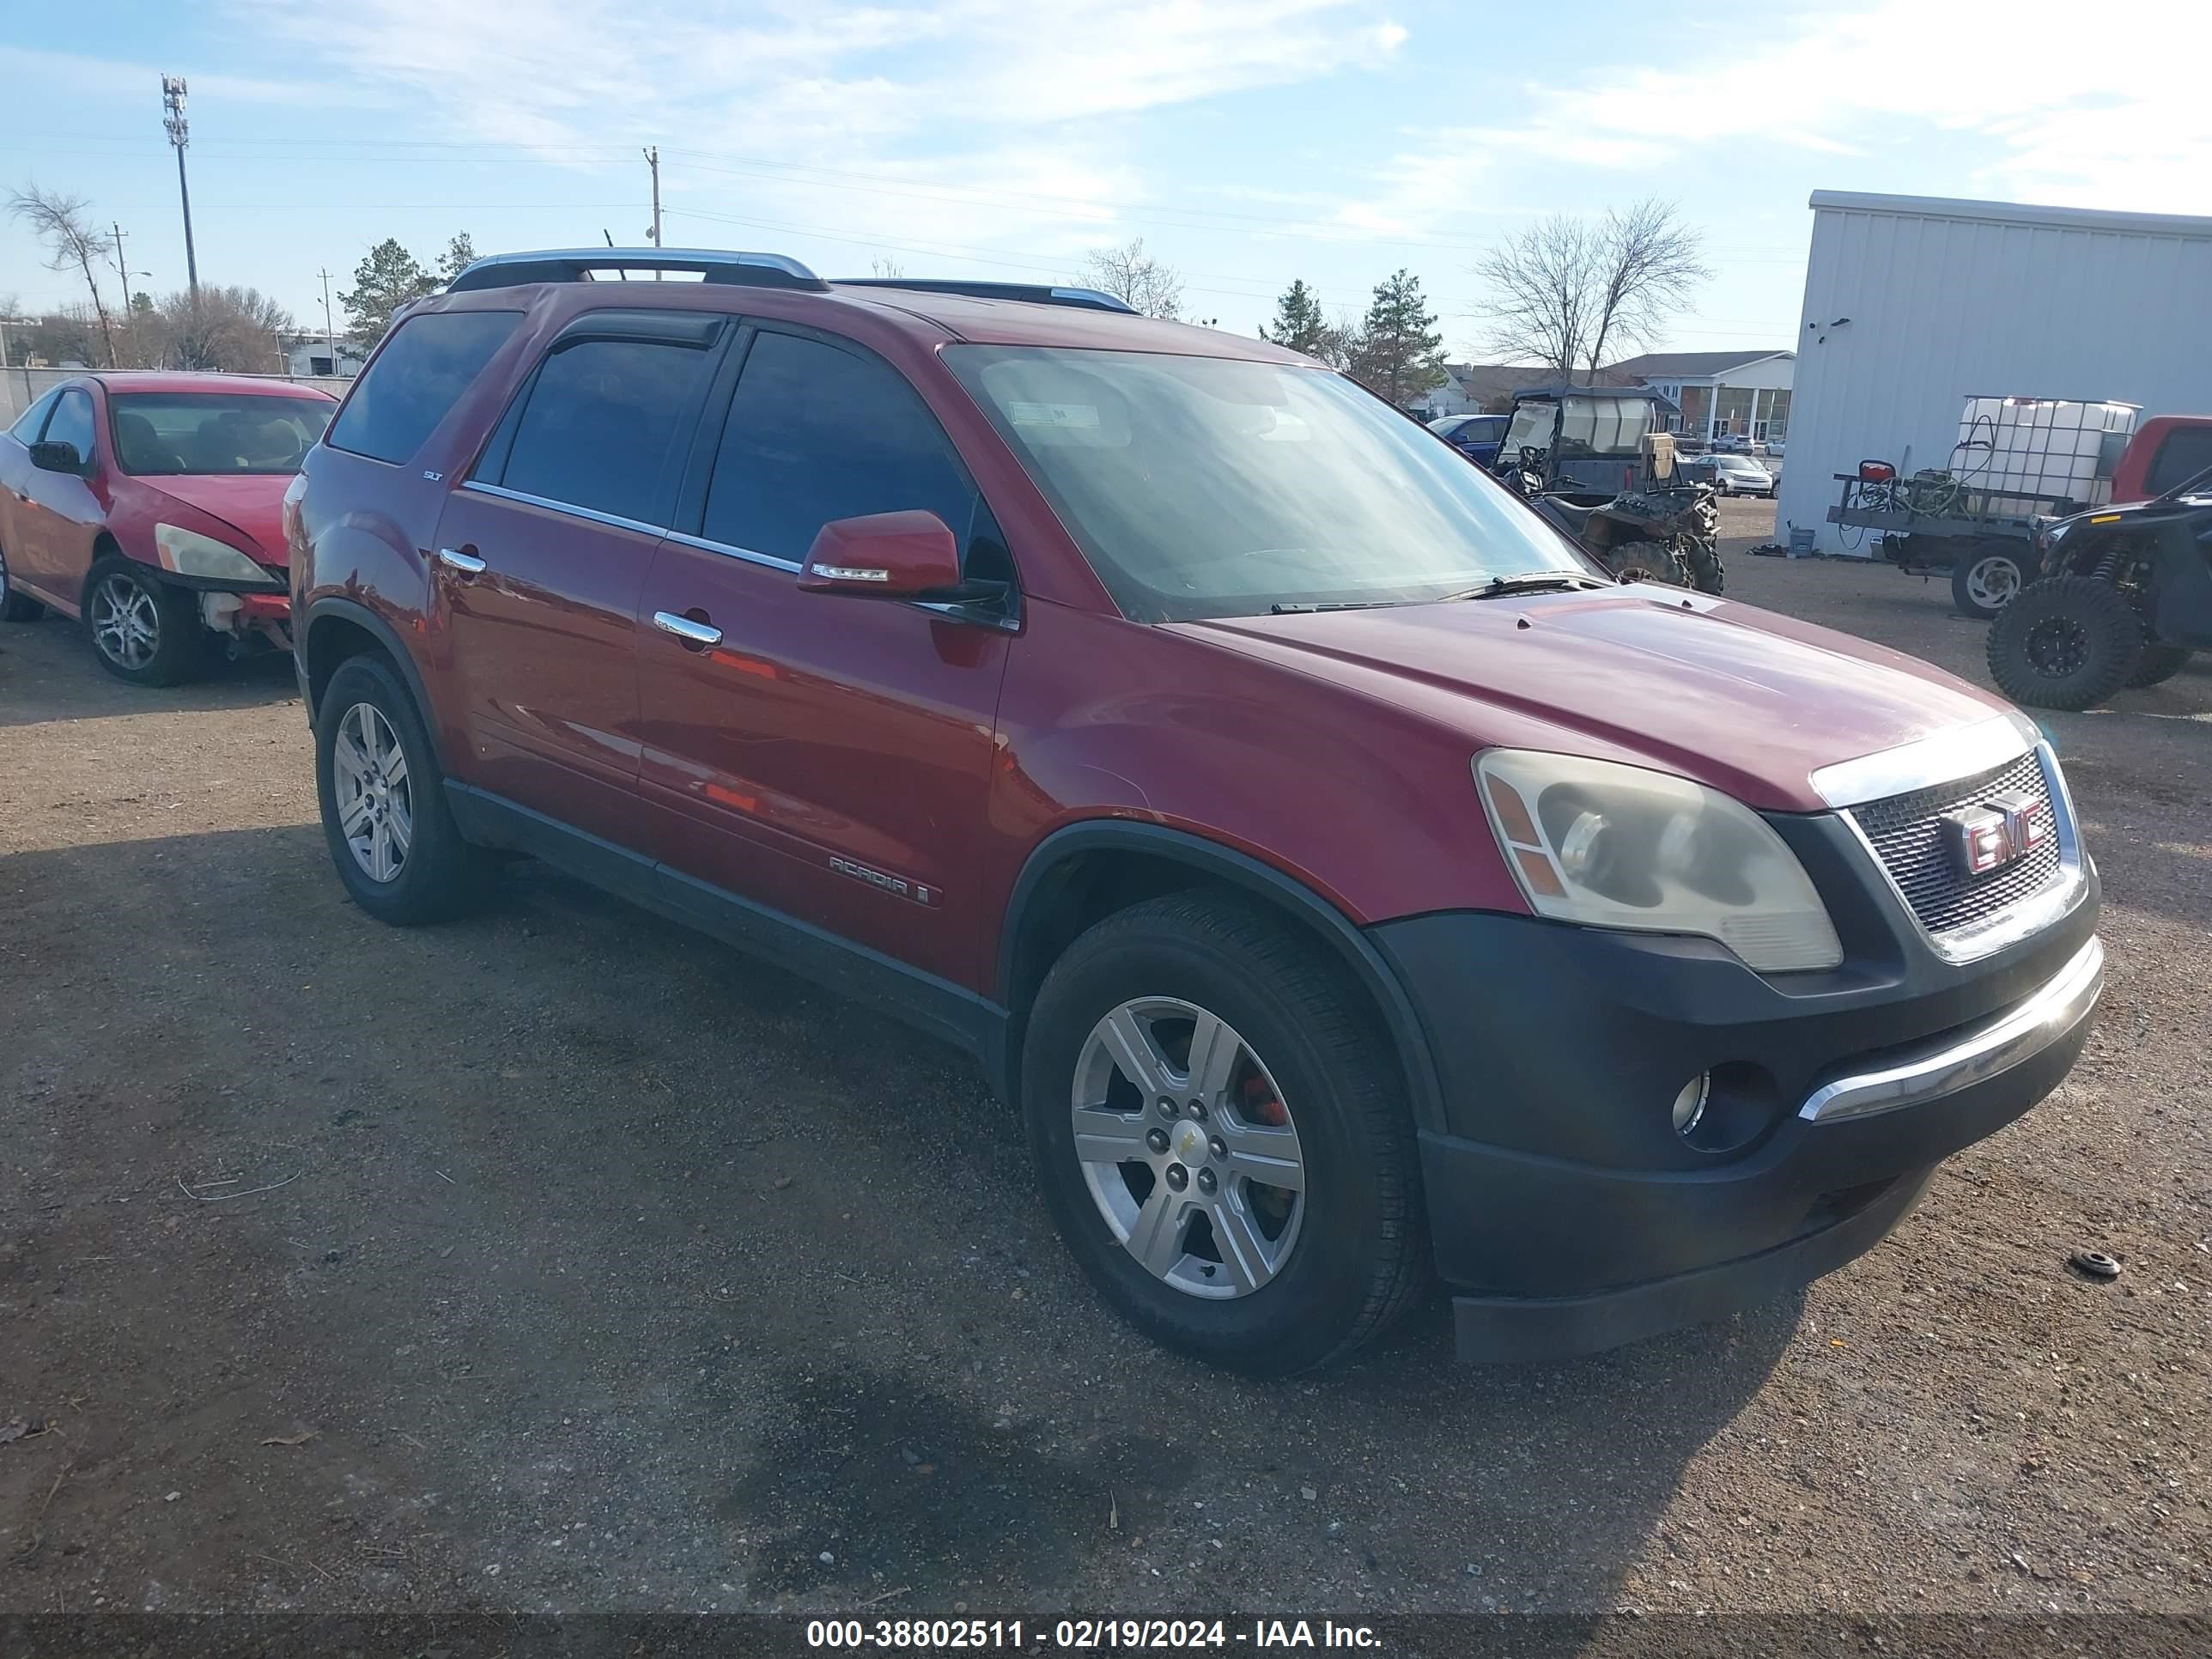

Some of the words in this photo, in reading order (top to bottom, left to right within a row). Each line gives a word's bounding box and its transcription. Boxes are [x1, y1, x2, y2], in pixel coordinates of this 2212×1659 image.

[422, 471, 443, 482] SLT
[1962, 795, 2046, 875] GMC
[830, 856, 908, 895] ACADIA
